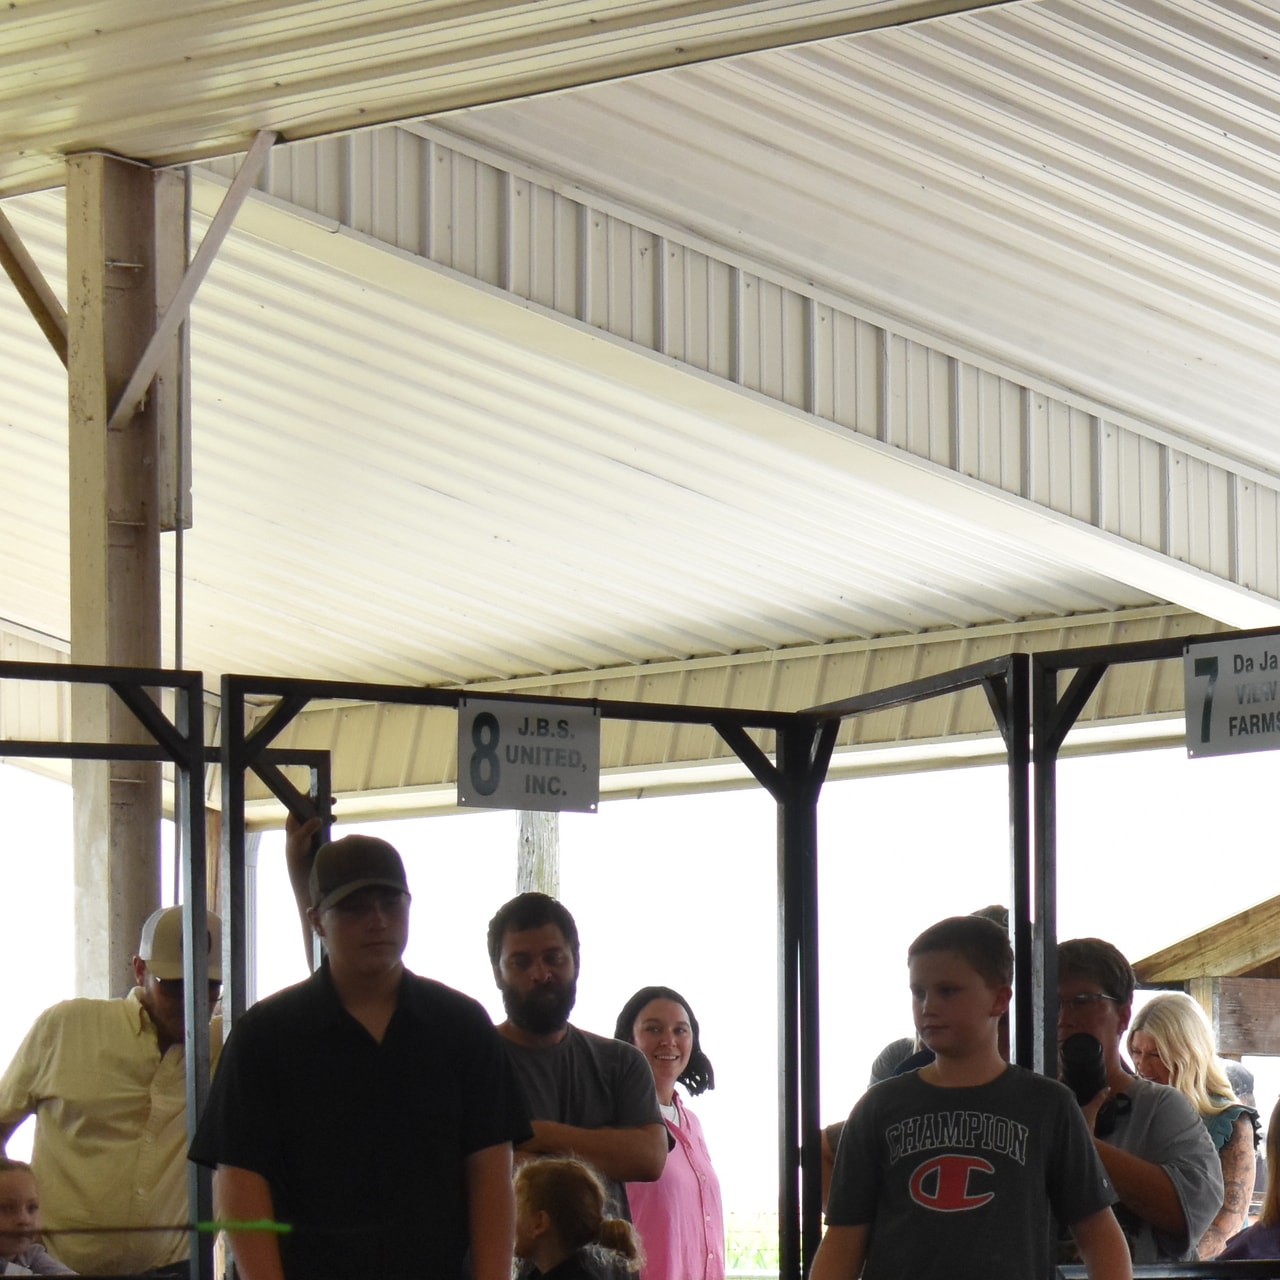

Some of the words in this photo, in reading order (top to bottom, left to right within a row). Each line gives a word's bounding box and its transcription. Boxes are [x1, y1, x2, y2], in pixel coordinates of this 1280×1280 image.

[1233, 653, 1255, 674] Da
[1259, 650, 1278, 672] Ja
[1194, 656, 1219, 744] 7
[518, 716, 576, 740] J.B.S.
[470, 711, 500, 797] 8
[505, 744, 588, 773] UNITED,
[525, 774, 568, 797] INC.
[885, 1110, 1029, 1166] CHAMPION
